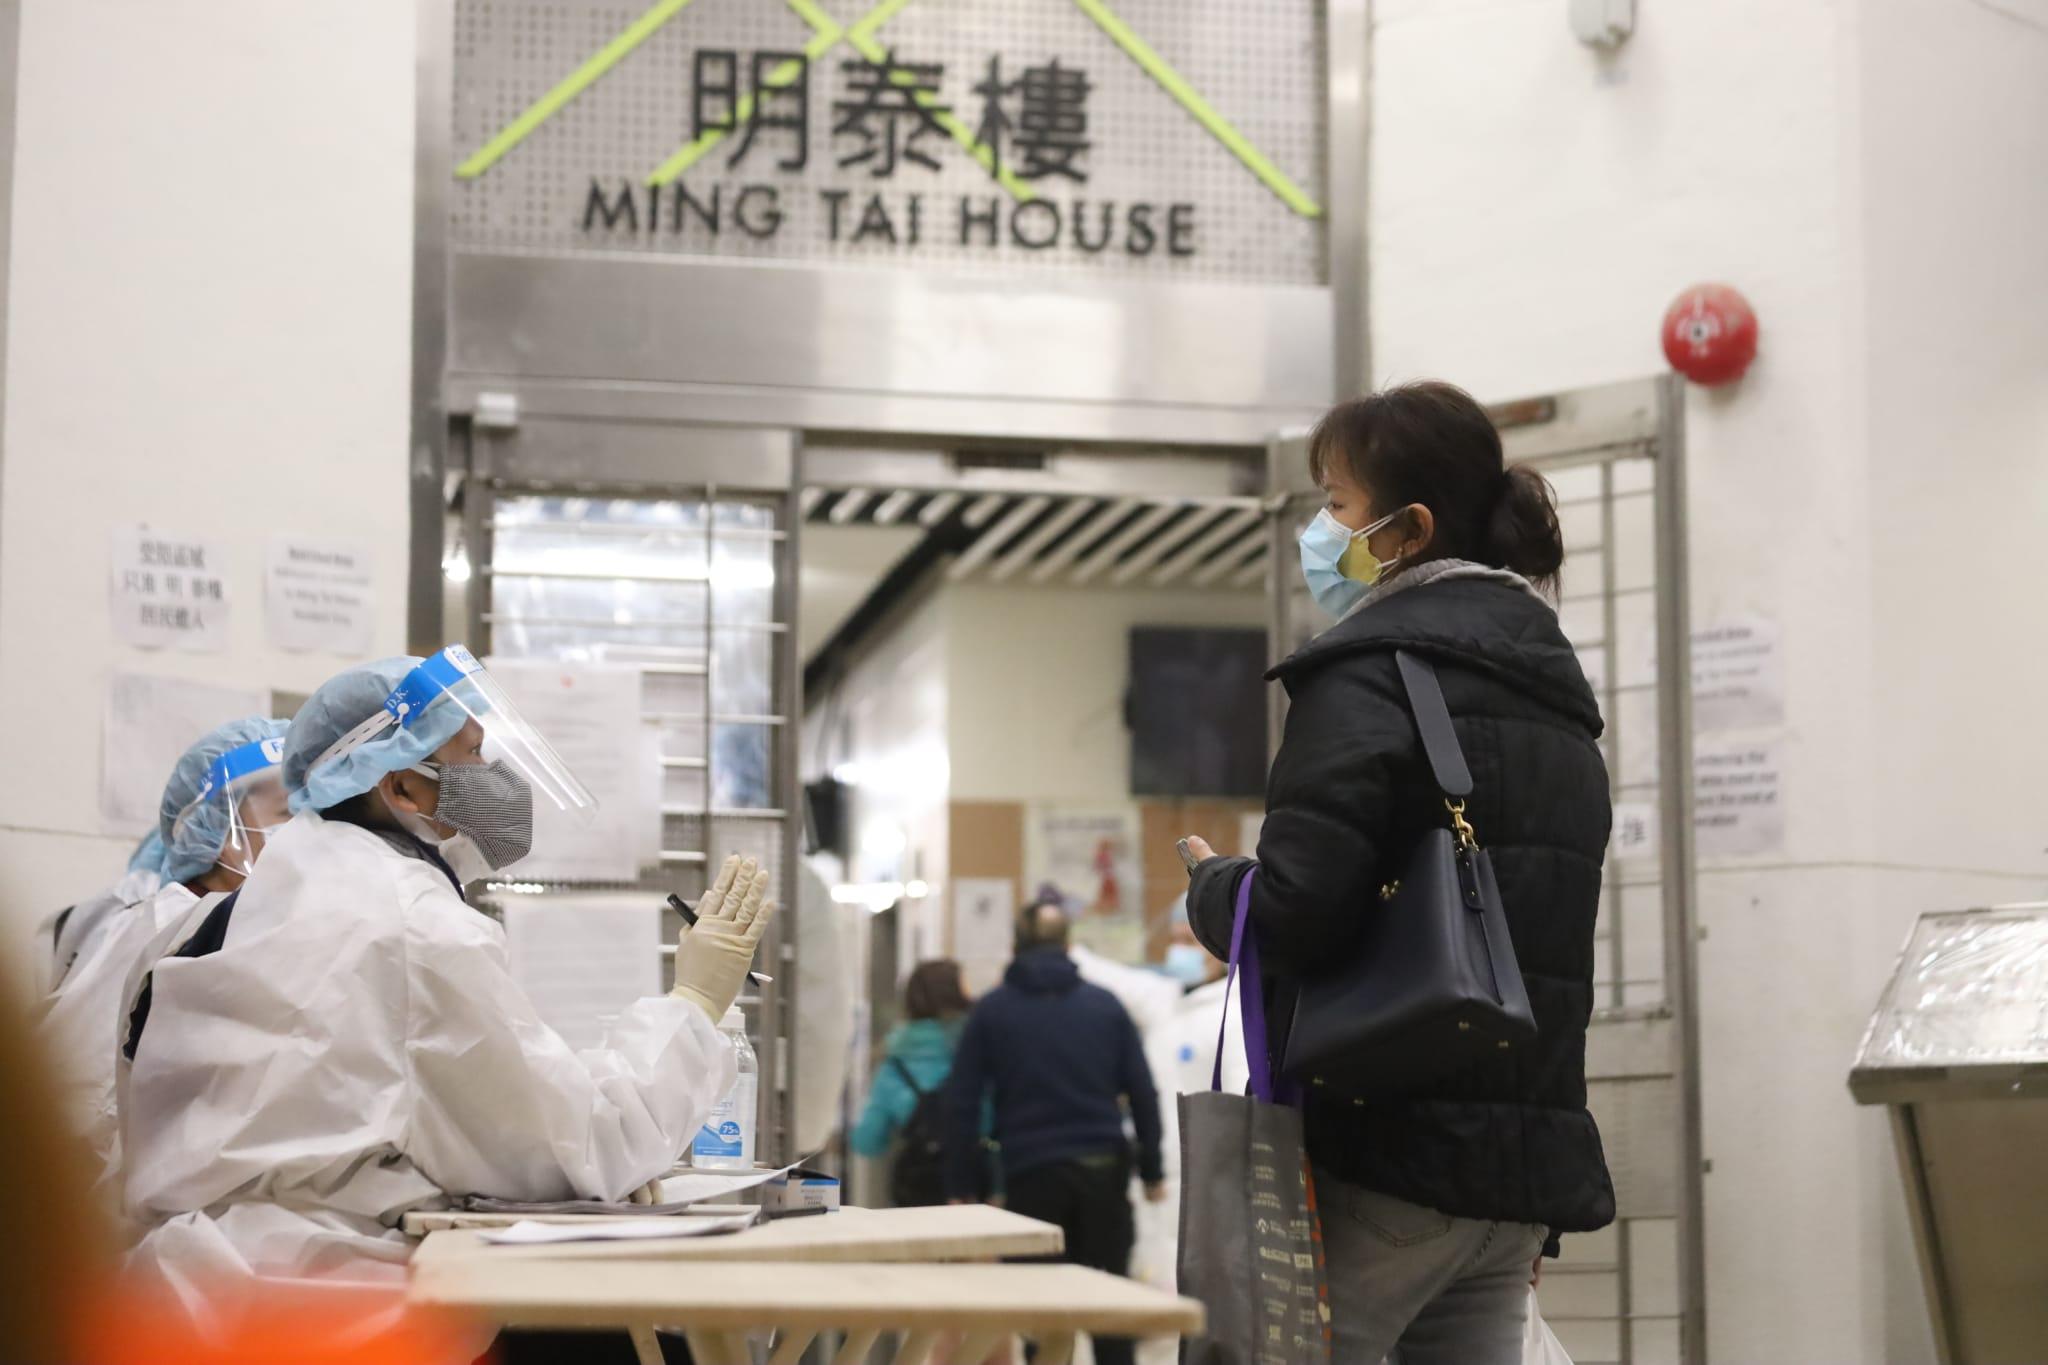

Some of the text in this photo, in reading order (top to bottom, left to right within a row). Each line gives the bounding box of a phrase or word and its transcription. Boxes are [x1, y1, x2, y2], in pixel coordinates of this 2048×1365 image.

[693, 47, 1093, 183] 明泰樓
[582, 177, 1196, 256] MING TAI HOUSE
